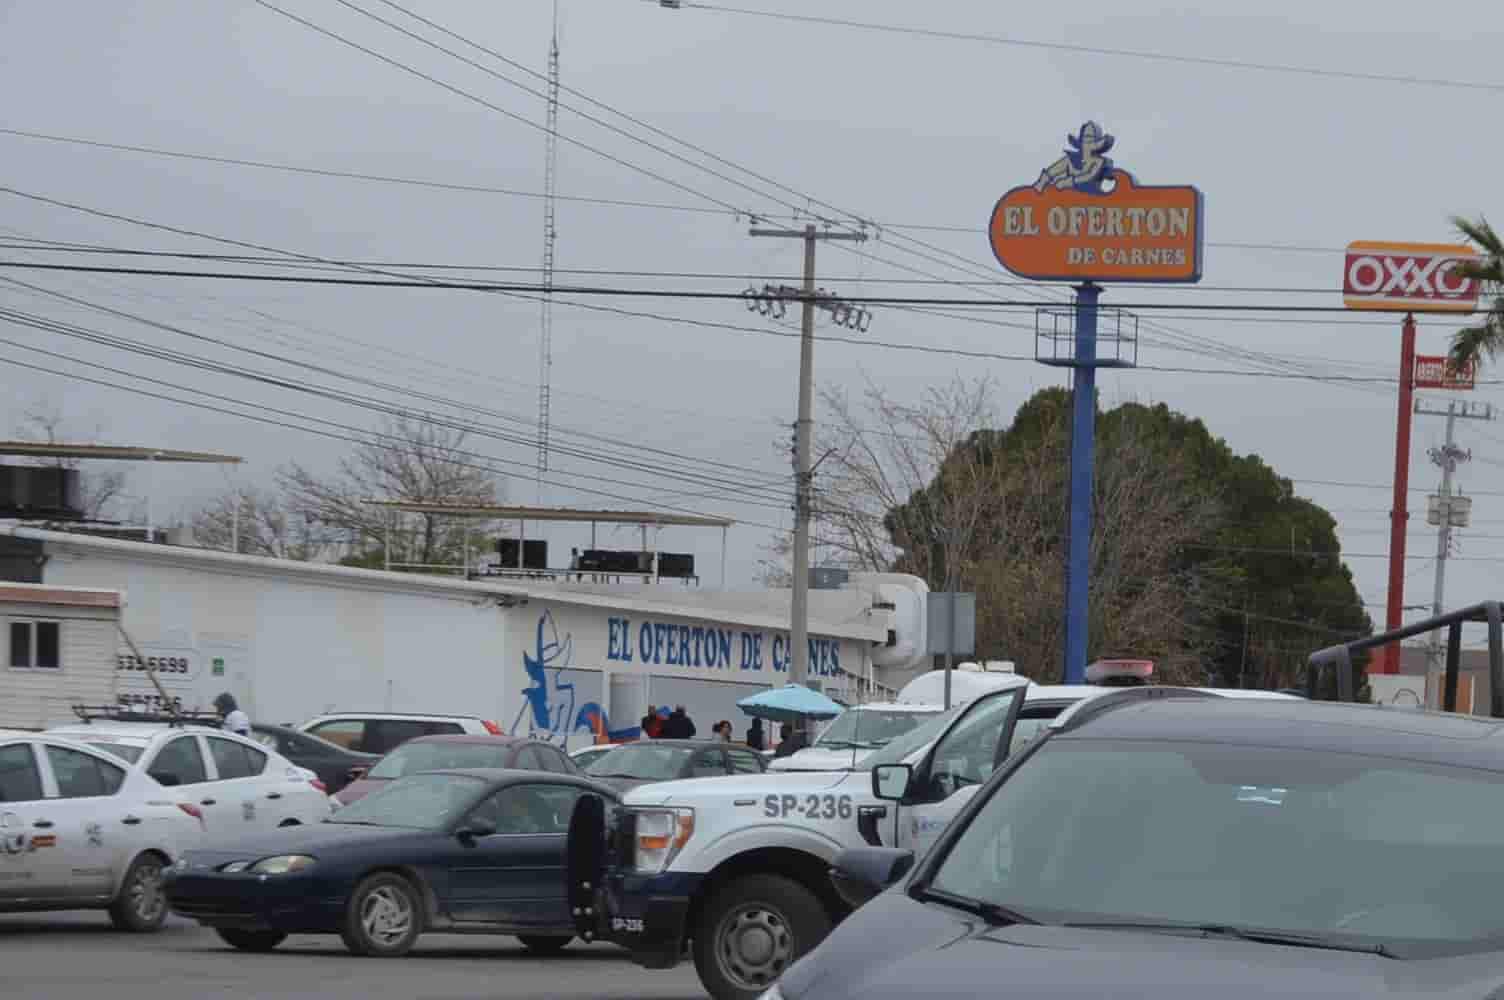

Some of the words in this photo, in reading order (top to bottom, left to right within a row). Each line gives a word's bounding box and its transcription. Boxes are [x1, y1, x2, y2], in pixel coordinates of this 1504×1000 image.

[1003, 206, 1041, 236] EL
[1047, 206, 1191, 237] OFERTON
[1065, 247, 1096, 265] DE
[1102, 247, 1186, 266] CARNES
[607, 617, 634, 663] EL
[639, 621, 733, 671] OFERTON
[740, 630, 764, 673] DE
[772, 635, 843, 676] CANES
[764, 795, 852, 819] SP-236
